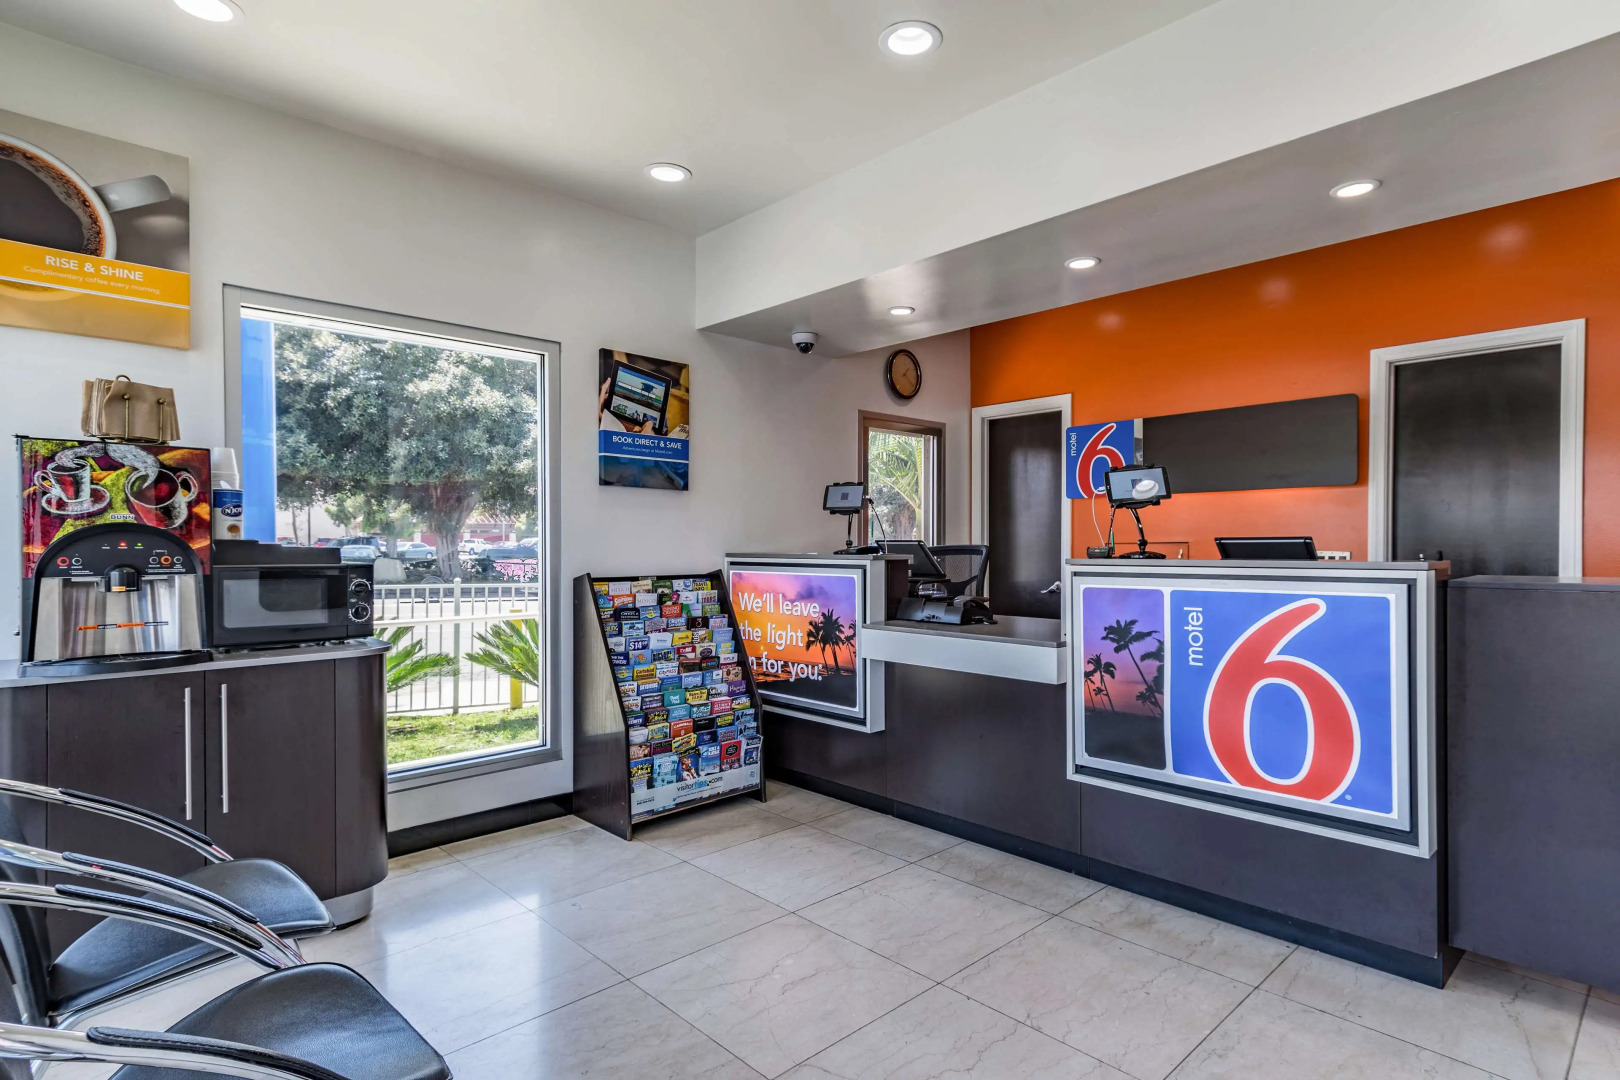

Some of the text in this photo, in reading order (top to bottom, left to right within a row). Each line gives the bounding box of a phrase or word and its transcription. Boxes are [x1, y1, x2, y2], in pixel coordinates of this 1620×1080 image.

[23, 265, 83, 282] Complimentary
[85, 277, 108, 286] coffee
[110, 280, 129, 290] every
[45, 255, 144, 281] RISE & SHINE
[612, 435, 682, 450] BOOK DIRECT & SAVE
[1069, 432, 1077, 456] motel
[1076, 422, 1126, 499] 6
[738, 592, 820, 618] We'll leave
[739, 620, 804, 651] the light
[1183, 606, 1204, 667] motel
[761, 651, 784, 674] for
[1203, 597, 1361, 804] 6
